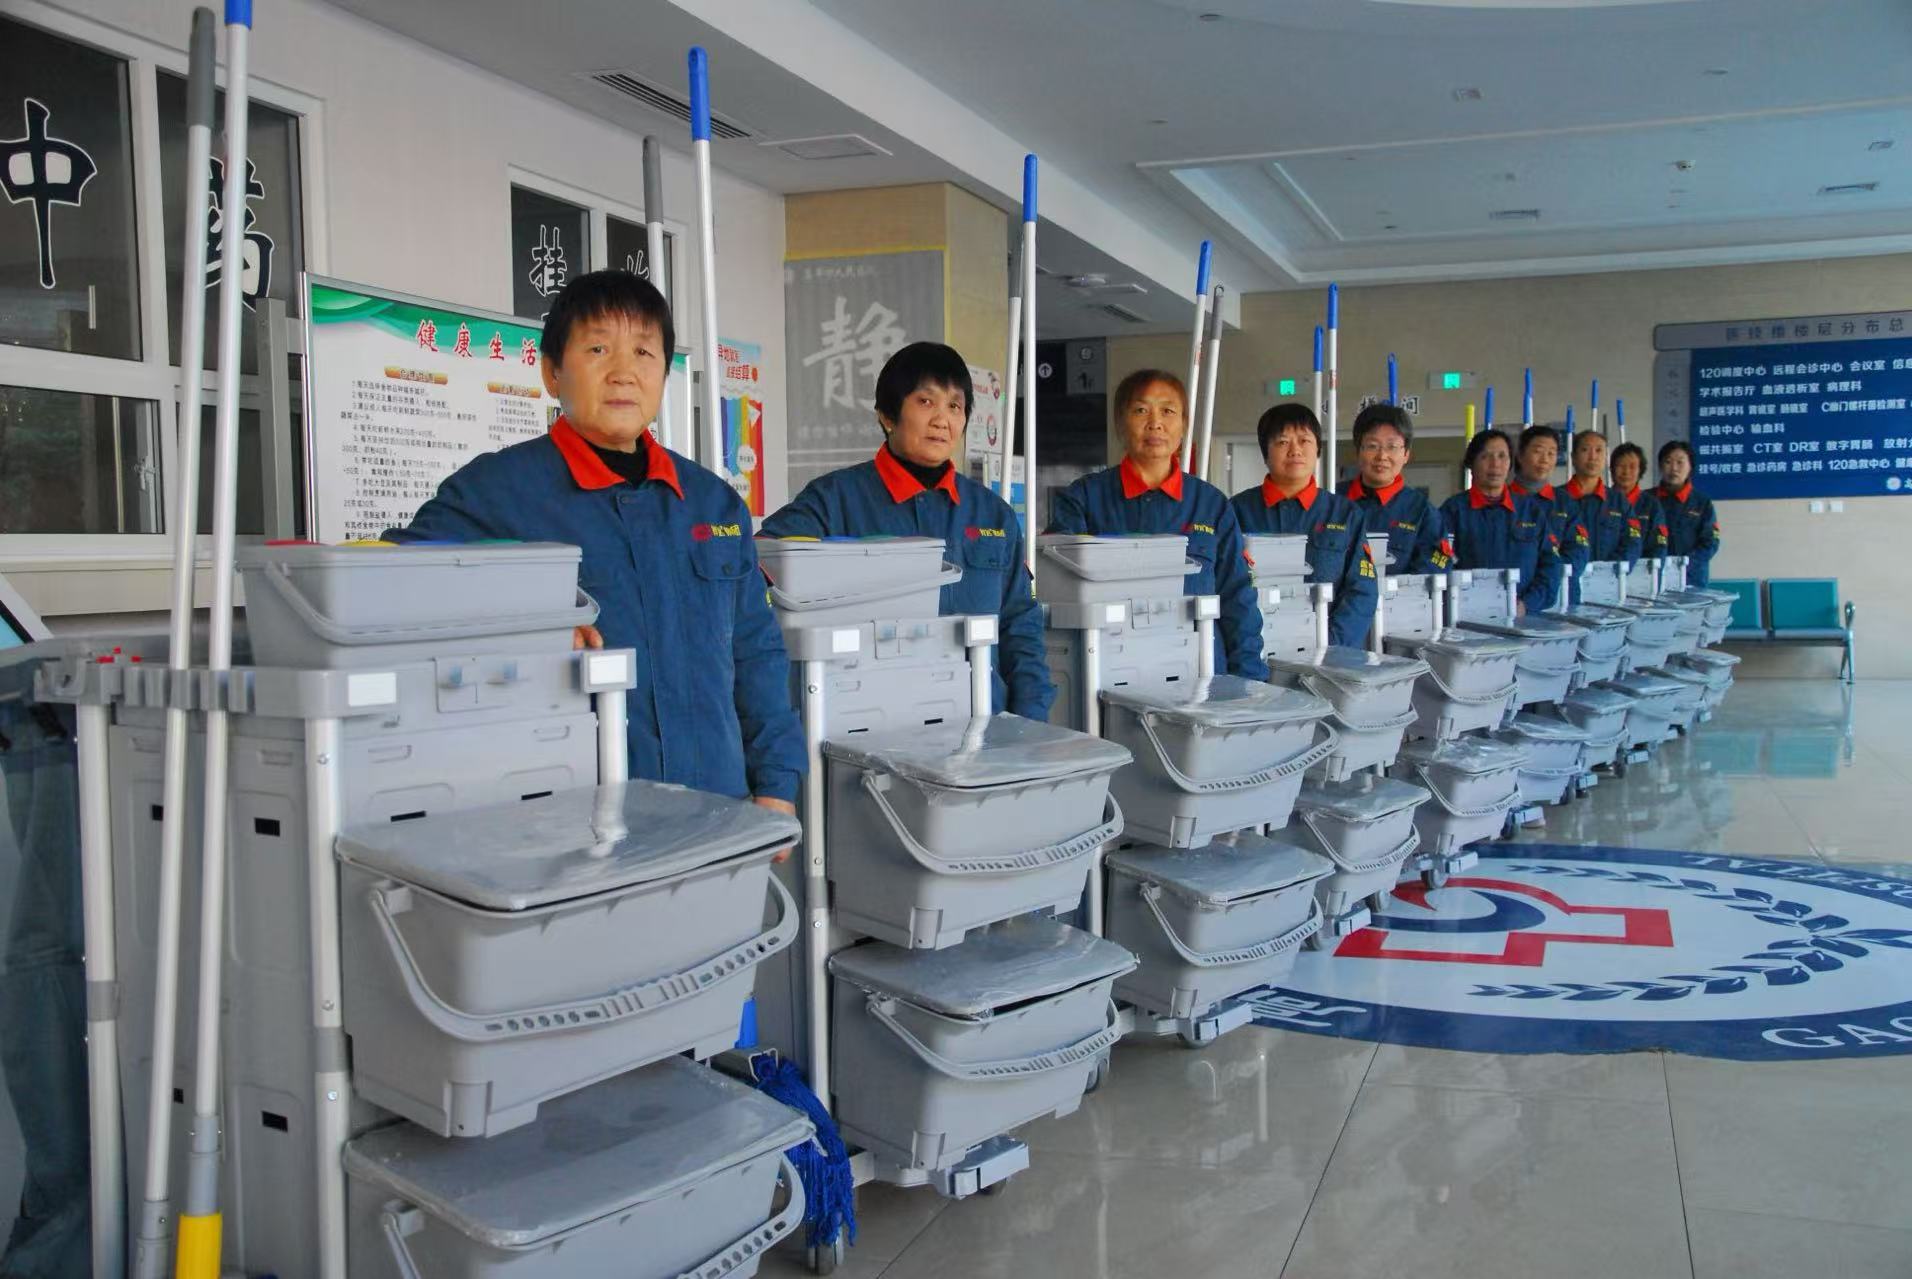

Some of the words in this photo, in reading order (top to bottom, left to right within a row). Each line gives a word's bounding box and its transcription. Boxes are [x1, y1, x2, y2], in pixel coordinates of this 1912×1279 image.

[417, 318, 537, 366] 健康生活
[803, 296, 907, 408] 静
[1700, 366, 1767, 379] 120调度中心
[1773, 363, 1843, 376] 远程会诊中心
[1850, 360, 1885, 372] 会议室
[1699, 385, 1756, 398] 学术报告厅
[1762, 383, 1820, 395] 血液透析室
[1827, 380, 1862, 392] 病理科
[1700, 424, 1744, 436] 检验中心
[1751, 422, 1785, 434] 输血科
[1753, 442, 1783, 454] CT室
[1789, 441, 1820, 453] DR室
[1746, 461, 1787, 473] 急诊药房
[1792, 460, 1822, 472] 急诊科
[1828, 458, 1890, 470] 120急救中心
